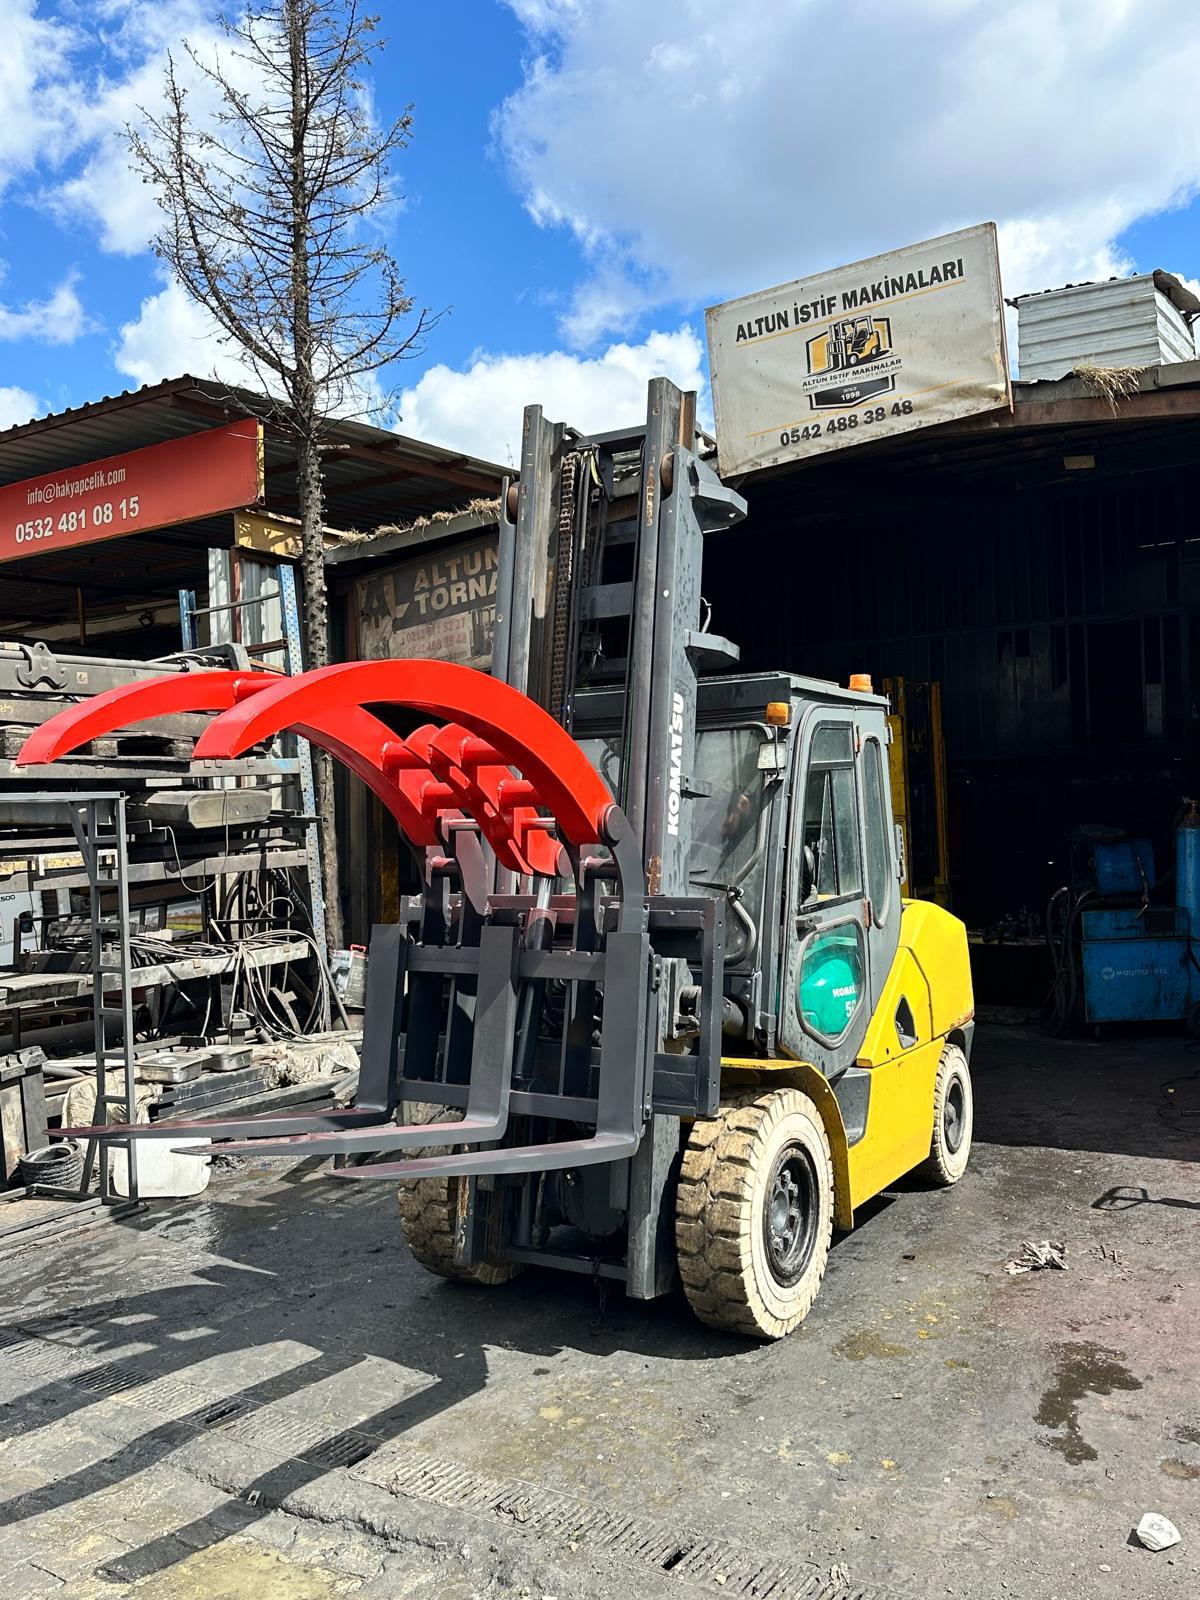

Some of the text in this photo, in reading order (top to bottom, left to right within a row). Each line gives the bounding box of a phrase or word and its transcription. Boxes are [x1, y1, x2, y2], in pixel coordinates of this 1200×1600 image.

[736, 258, 964, 342] ALTUN İSTİF MAKİNALARI
[802, 376, 828, 387] ALTUN
[841, 391, 861, 401] 1998
[780, 400, 913, 446] 0542 488 38 48
[27, 467, 126, 505] info@hakyapcelik.com
[15, 496, 140, 543] 0532 481 08 15
[414, 544, 499, 592] ALTUN
[667, 692, 684, 836] KOMATSU
